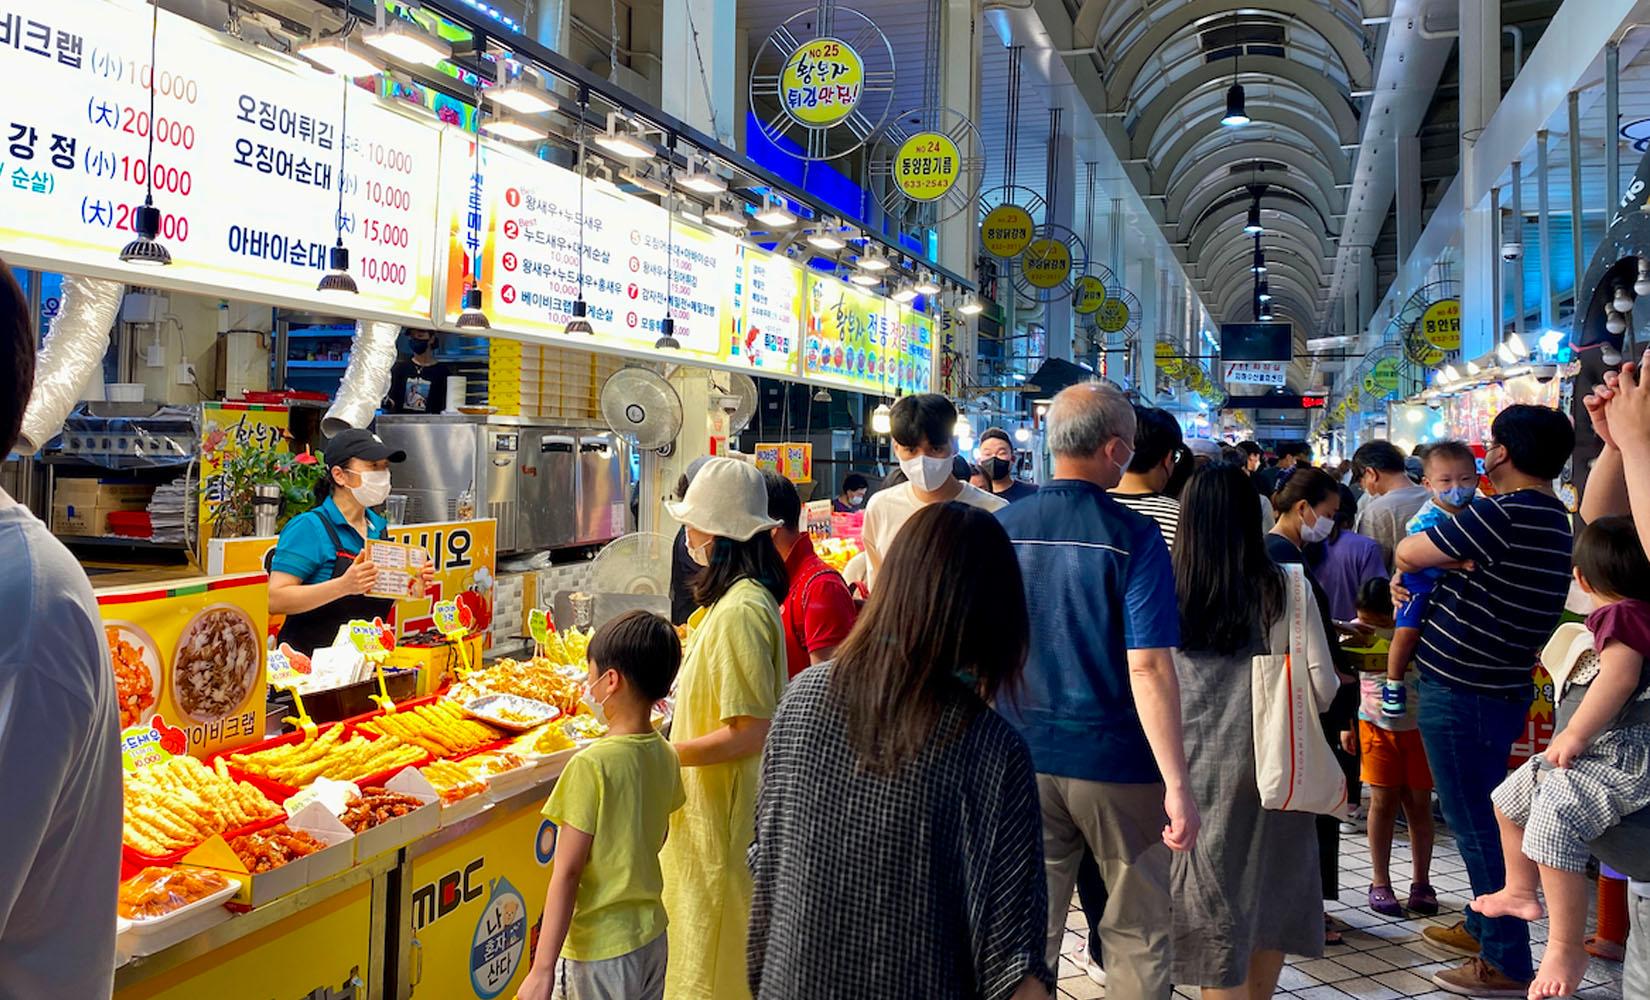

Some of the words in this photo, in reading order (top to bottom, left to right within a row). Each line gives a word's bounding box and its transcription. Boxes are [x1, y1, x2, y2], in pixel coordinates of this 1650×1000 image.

[824, 44, 839, 57] 25
[129, 61, 197, 104] 10,000
[123, 107, 195, 150] 20,000
[237, 94, 334, 150] 오징어튀김
[369, 143, 412, 174] 10,000
[927, 142, 940, 152] 24
[122, 156, 192, 196] 10,000
[234, 138, 332, 190] 오징어순대
[366, 180, 410, 211] 10,000
[902, 157, 952, 175] 동양참기름
[904, 180, 949, 188] 633-2543
[116, 203, 189, 242] 2000
[363, 218, 408, 248] 15,000
[228, 225, 327, 270] 아바이순대
[360, 256, 406, 285] 10,000
[134, 753, 161, 768] 10,000
[412, 858, 484, 930] MBC
[486, 907, 503, 937] 나
[483, 934, 508, 962] 혼자
[487, 953, 513, 988] 산다
